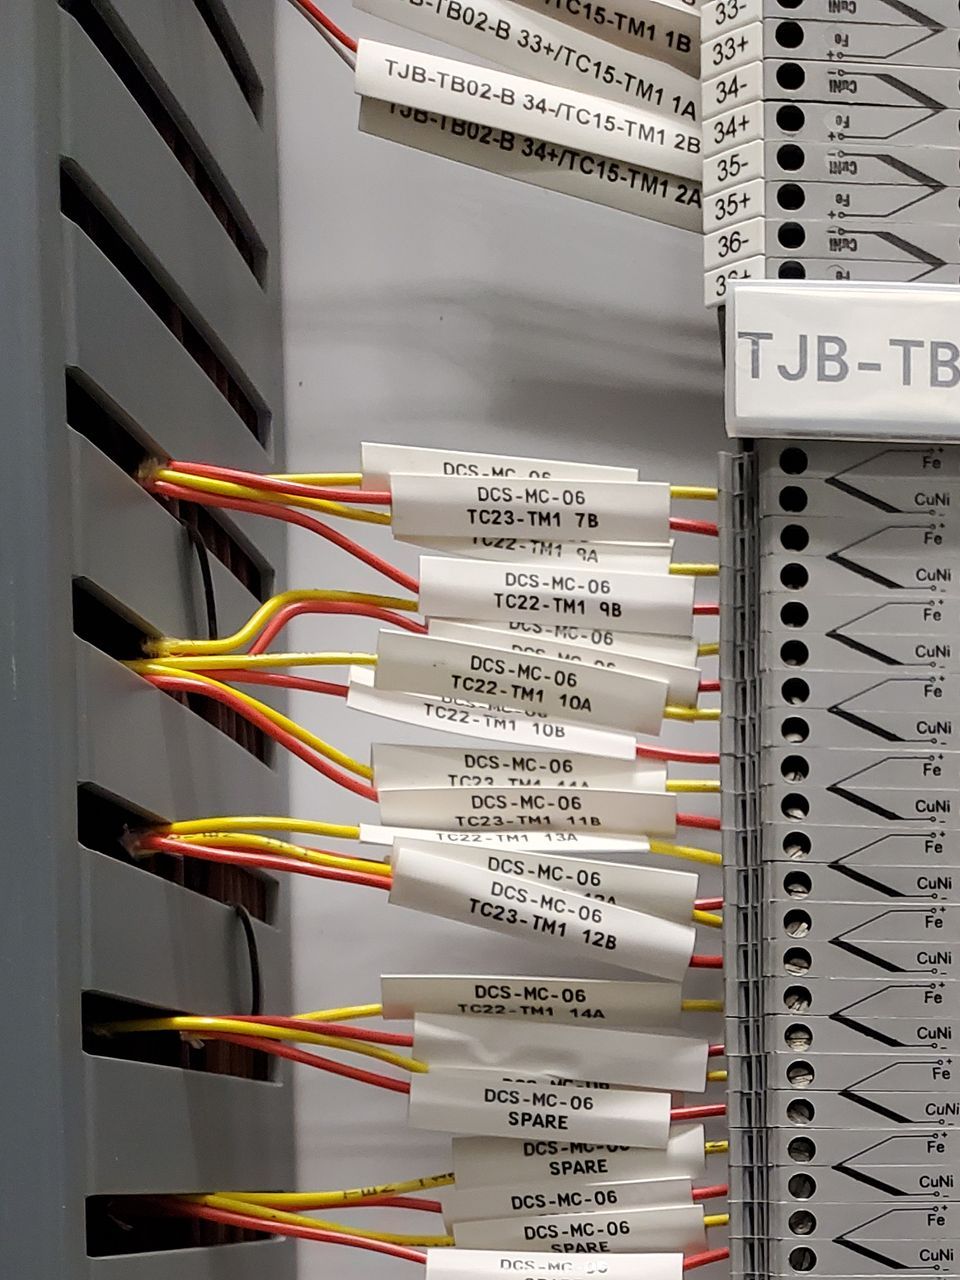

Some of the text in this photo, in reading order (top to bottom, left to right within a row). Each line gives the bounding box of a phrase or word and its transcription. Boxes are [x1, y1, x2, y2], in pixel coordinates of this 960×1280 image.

[715, 0, 747, 25] 33-
[665, 31, 691, 52] 1B
[712, 37, 749, 65] 33+
[517, 30, 697, 120] 33+/TC15-TM1 1A
[715, 75, 747, 104] 34-
[385, 58, 701, 154] TJB-TB02-B 34-/TC15-TM1 2B
[713, 115, 749, 144] 34+
[717, 153, 748, 181] 35-
[675, 185, 702, 208] 2A
[715, 193, 751, 221] 35+
[717, 230, 749, 257] 36-
[478, 487, 586, 505] DCS-MC-06
[467, 509, 599, 529] TC23-TM1 7B
[505, 573, 611, 594] DCS-MC-06
[494, 593, 621, 617] TC22-TM1 9B
[471, 655, 577, 688] DCS-MC-06
[451, 675, 544, 702] TC22-TM1
[560, 695, 592, 713] 10A
[424, 703, 516, 731] TC22-TM1
[532, 723, 565, 738] 10B
[464, 755, 572, 774] DCS-MC-06
[472, 796, 581, 811] DCS-MC-06
[455, 816, 601, 827] TC23-TM1 11B
[925, 841, 942, 853] Fe
[917, 877, 952, 890] CuNi
[491, 882, 603, 923] DCS-MC-06
[469, 898, 617, 950] TC23-TM1 12B
[475, 985, 586, 1002] DCS-MC-06
[458, 1004, 605, 1019] TC22-TM1 14A
[484, 1089, 593, 1110] DCS-MC-06
[508, 1112, 568, 1130] SPARE
[549, 1160, 608, 1176] SPARE
[511, 1191, 617, 1210] DCS-MC-06
[524, 1221, 630, 1240] DCS-MC-06
[928, 1214, 945, 1226] Fe
[920, 1249, 954, 1262] CuNi
